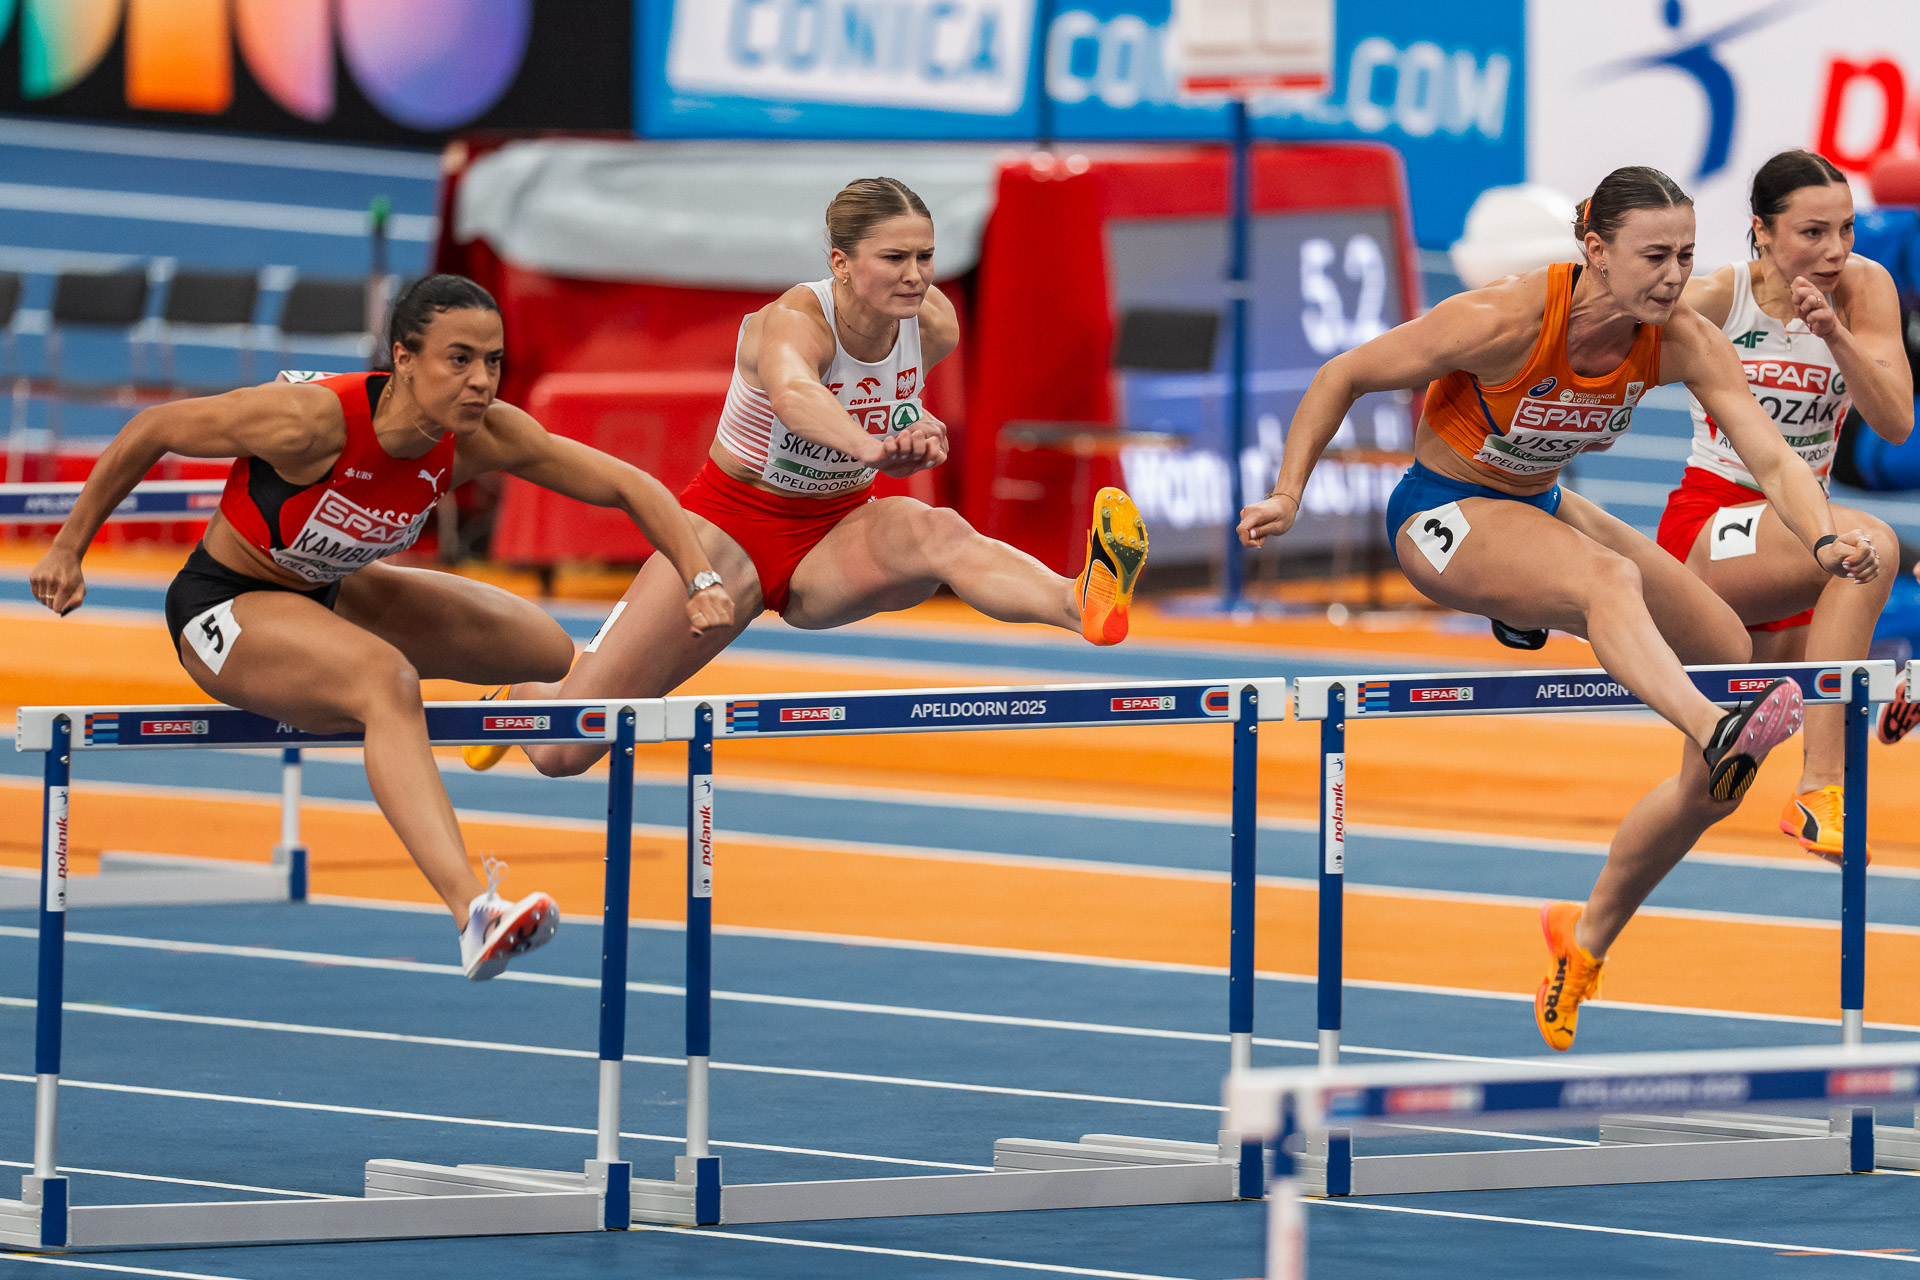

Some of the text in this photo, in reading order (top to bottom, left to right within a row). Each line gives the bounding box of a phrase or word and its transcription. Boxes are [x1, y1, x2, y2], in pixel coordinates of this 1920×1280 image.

[1519, 406, 1609, 429] SPAR
[1753, 395, 1842, 426] OZÁK
[355, 470, 374, 480] UBS
[769, 471, 859, 491] APELDOORN
[1423, 518, 1454, 554] 3
[1718, 518, 1754, 543] 2
[200, 613, 225, 655] 5
[1421, 689, 1458, 699] SPAR
[1536, 683, 1629, 699] APELDOORN
[910, 700, 1047, 718] APELDOORN 2025
[1122, 699, 1160, 709] SPAR
[495, 718, 534, 728] SPAR
[791, 710, 830, 720] SPAR
[153, 722, 192, 732] SPAR
[1332, 782, 1344, 843] polanik
[699, 805, 712, 866] polanik
[55, 816, 68, 879] polanik
